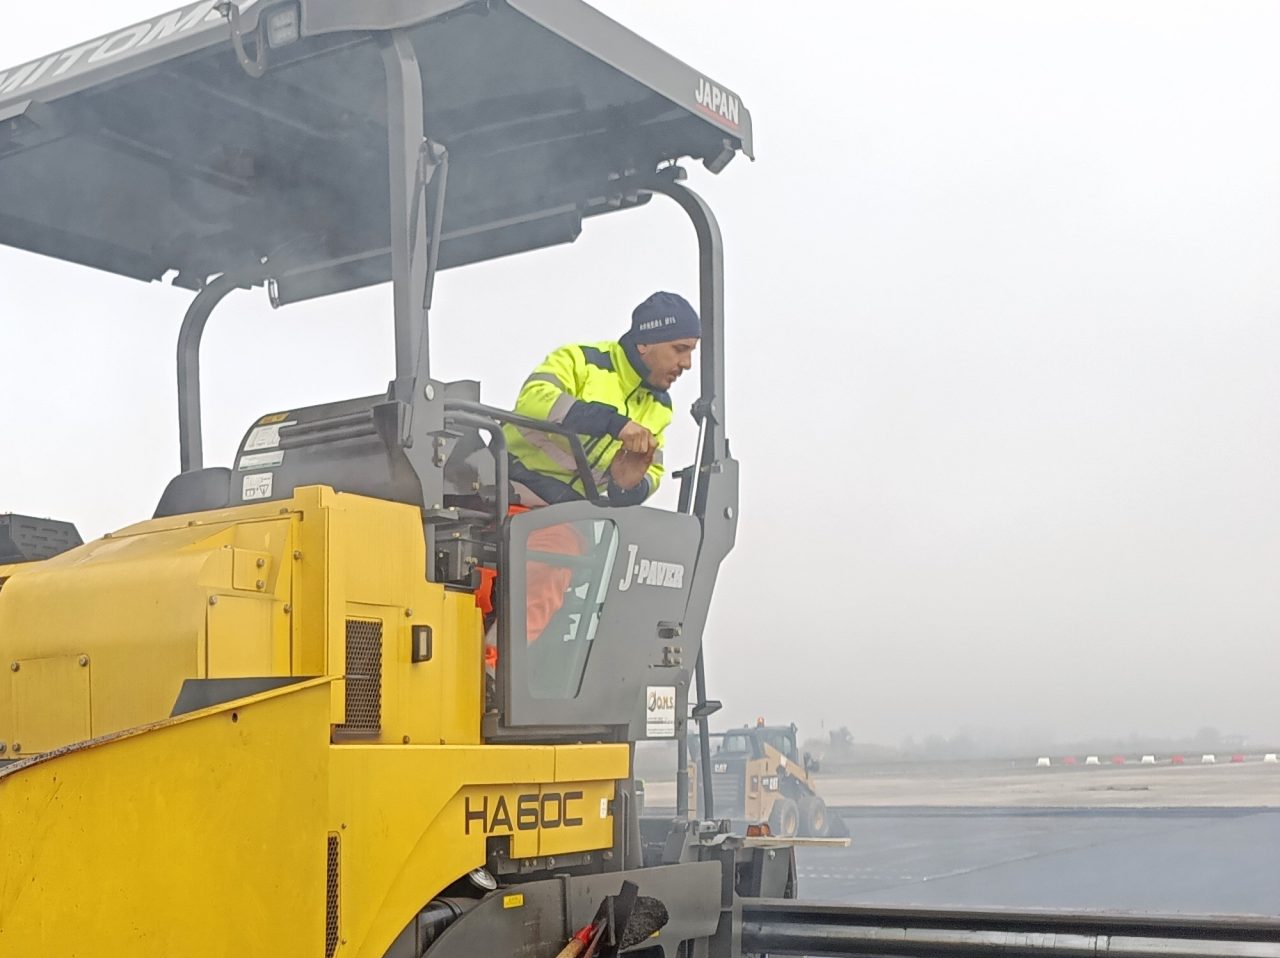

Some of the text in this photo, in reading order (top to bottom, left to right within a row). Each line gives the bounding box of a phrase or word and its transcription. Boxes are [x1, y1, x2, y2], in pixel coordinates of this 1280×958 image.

[695, 77, 739, 125] JAPAN
[618, 544, 684, 591] J-PAVER
[465, 790, 583, 835] HA60C
